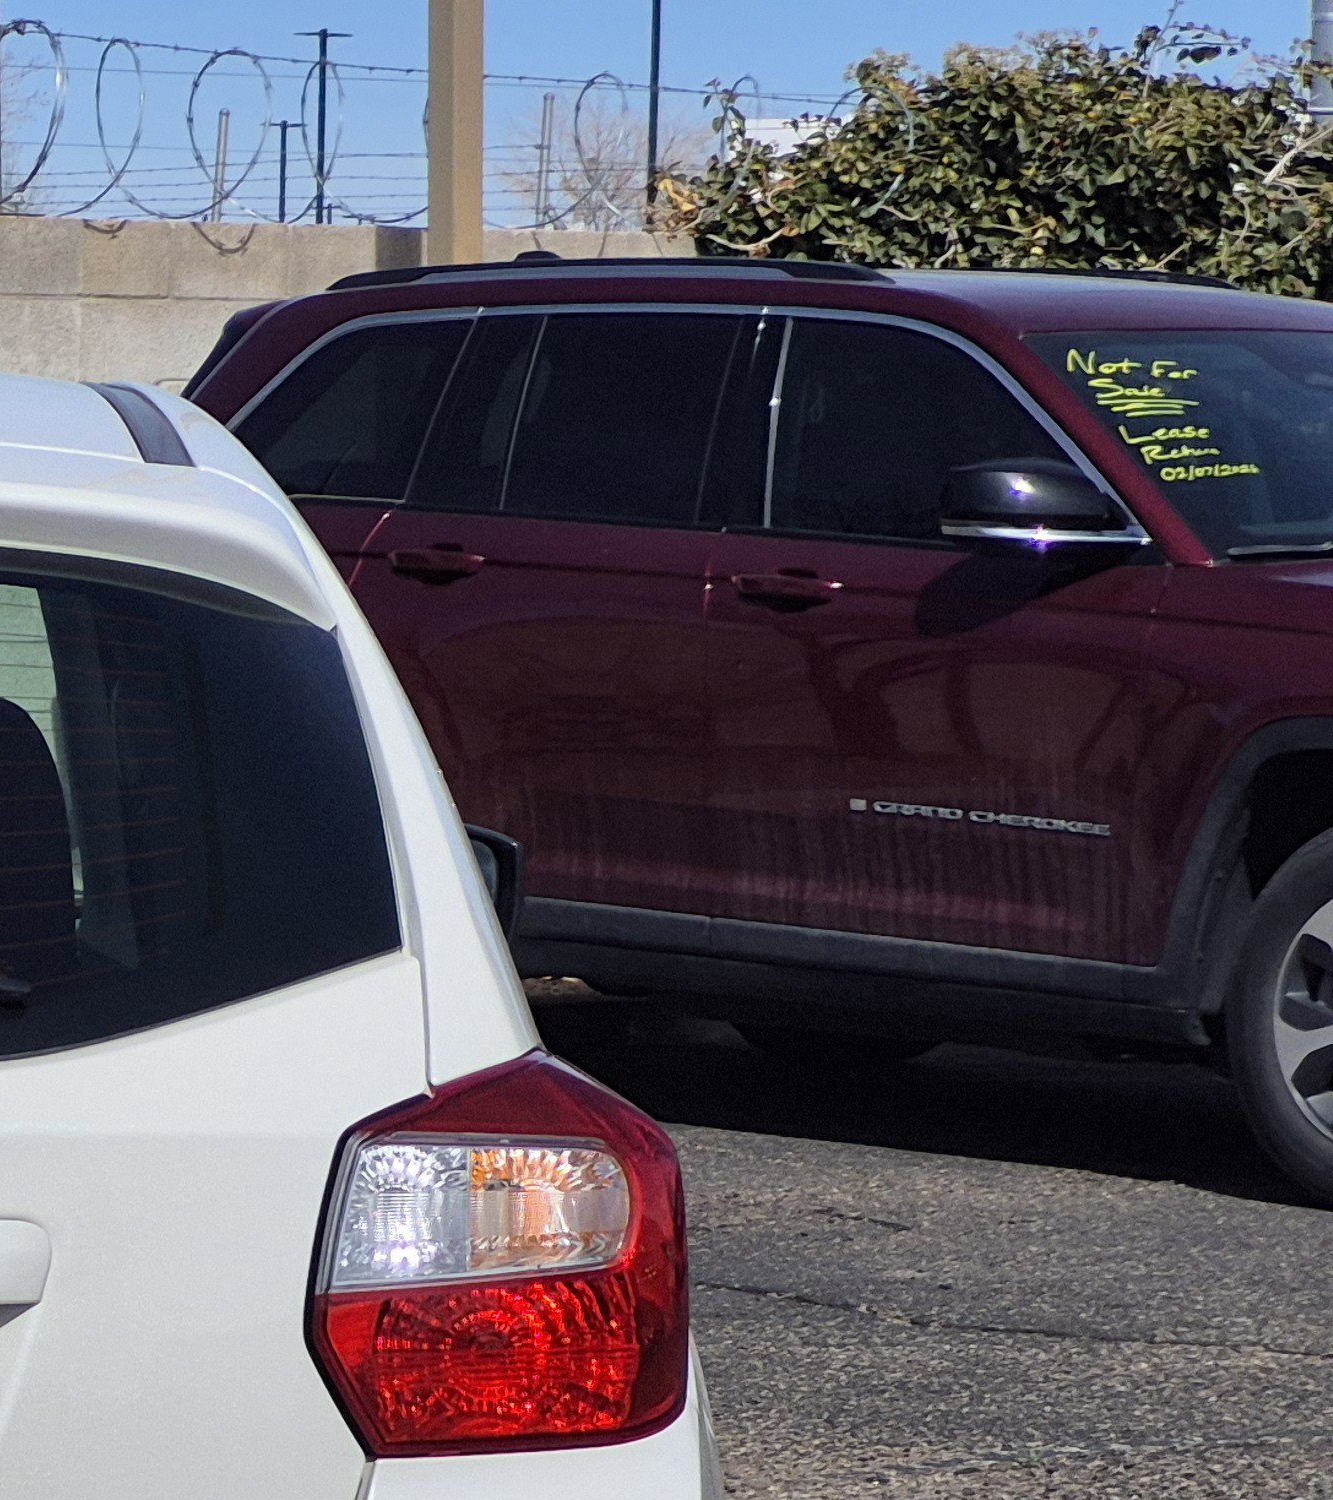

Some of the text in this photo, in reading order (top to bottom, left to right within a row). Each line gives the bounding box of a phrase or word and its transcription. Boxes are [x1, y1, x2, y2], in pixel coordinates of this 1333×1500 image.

[1066, 348, 1199, 380] Not For
[1087, 378, 1166, 399] Sale
[1118, 424, 1210, 445] Lease
[872, 800, 1111, 837] GRAND CHEROKEE
